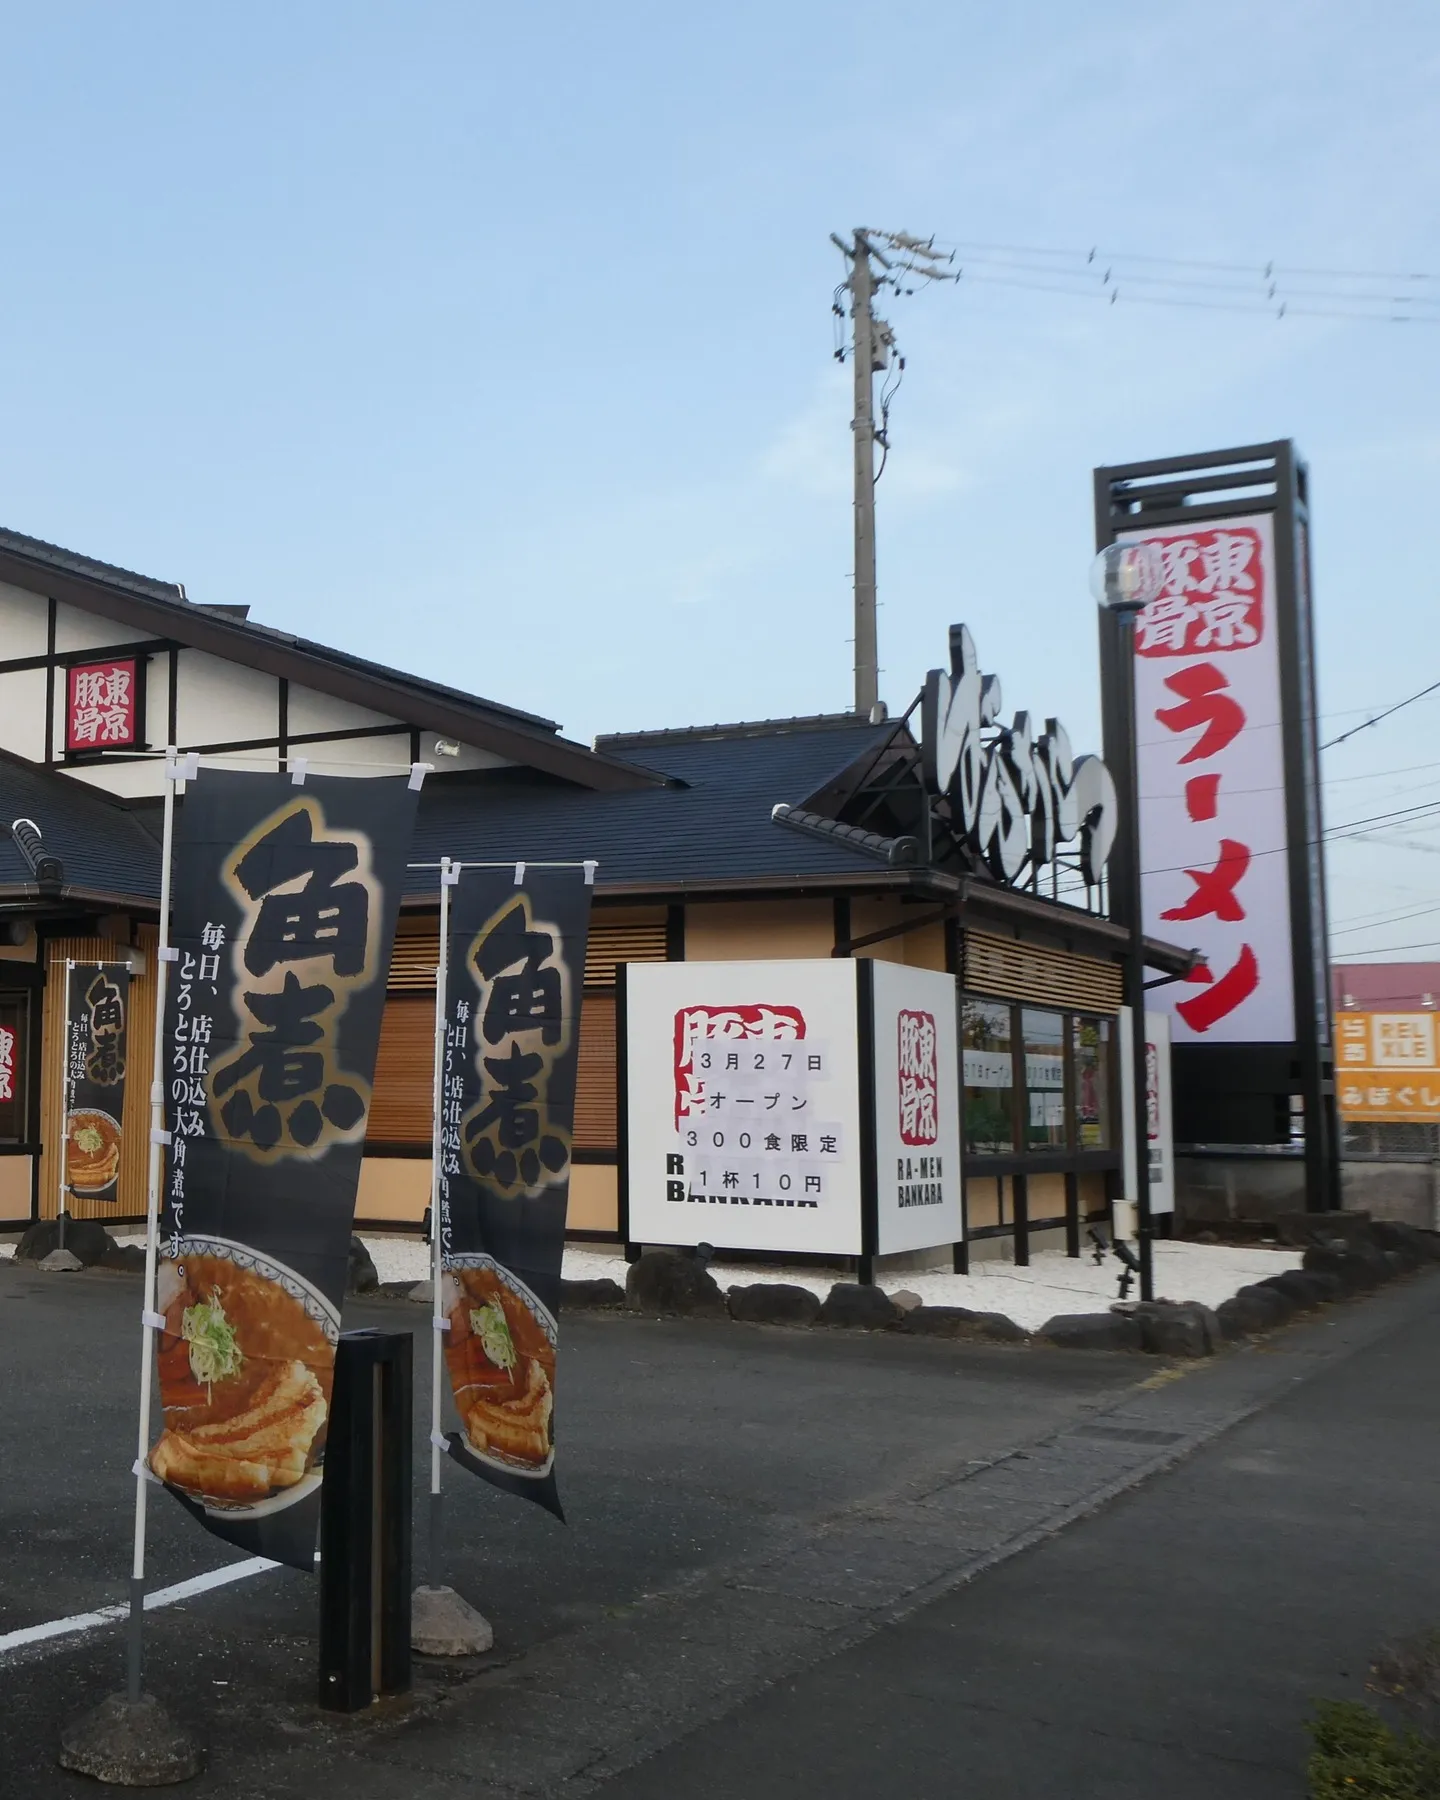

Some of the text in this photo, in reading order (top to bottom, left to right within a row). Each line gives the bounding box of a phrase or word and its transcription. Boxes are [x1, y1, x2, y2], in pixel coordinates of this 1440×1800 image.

[1195, 532, 1258, 648] 東京
[74, 671, 104, 742] 豚骨
[101, 668, 130, 741] 東京
[1155, 662, 1260, 1032] ラーメン
[210, 803, 376, 1157] 角煮
[86, 974, 125, 1084] 角煮
[188, 921, 226, 1137] 毎日、店仕込み
[463, 898, 570, 1193] 角煮
[700, 1052, 822, 1071] 3月27日
[709, 1091, 807, 1110] オープン
[686, 1130, 838, 1153] 300食限定
[699, 1170, 821, 1193] 1杯10円
[898, 1183, 943, 1208] BANKARA
